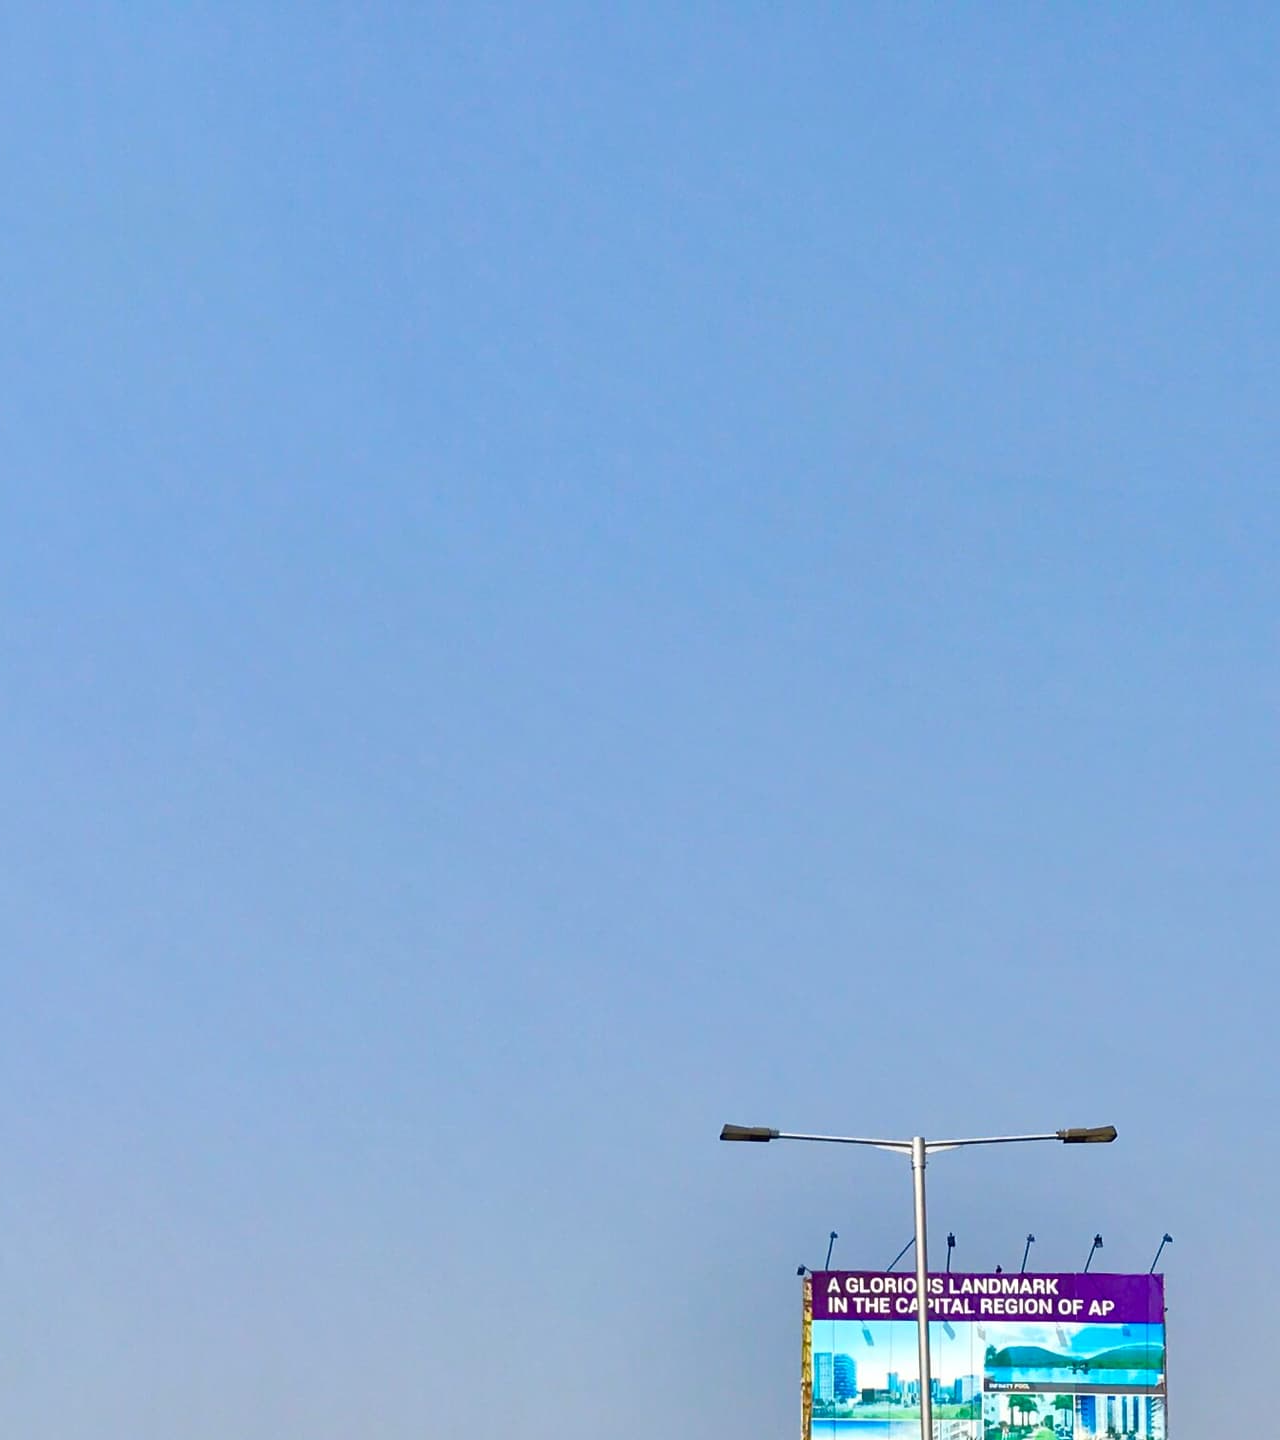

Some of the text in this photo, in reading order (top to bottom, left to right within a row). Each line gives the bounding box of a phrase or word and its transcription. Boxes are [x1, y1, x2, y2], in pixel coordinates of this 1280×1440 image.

[827, 1278, 840, 1293] A
[949, 1278, 1059, 1295] LANDMARK
[828, 1298, 848, 1313] IN
[853, 1297, 891, 1313] THE
[980, 1298, 1052, 1315] REGION
[1058, 1299, 1084, 1316] OF
[1088, 1300, 1115, 1316] AP
